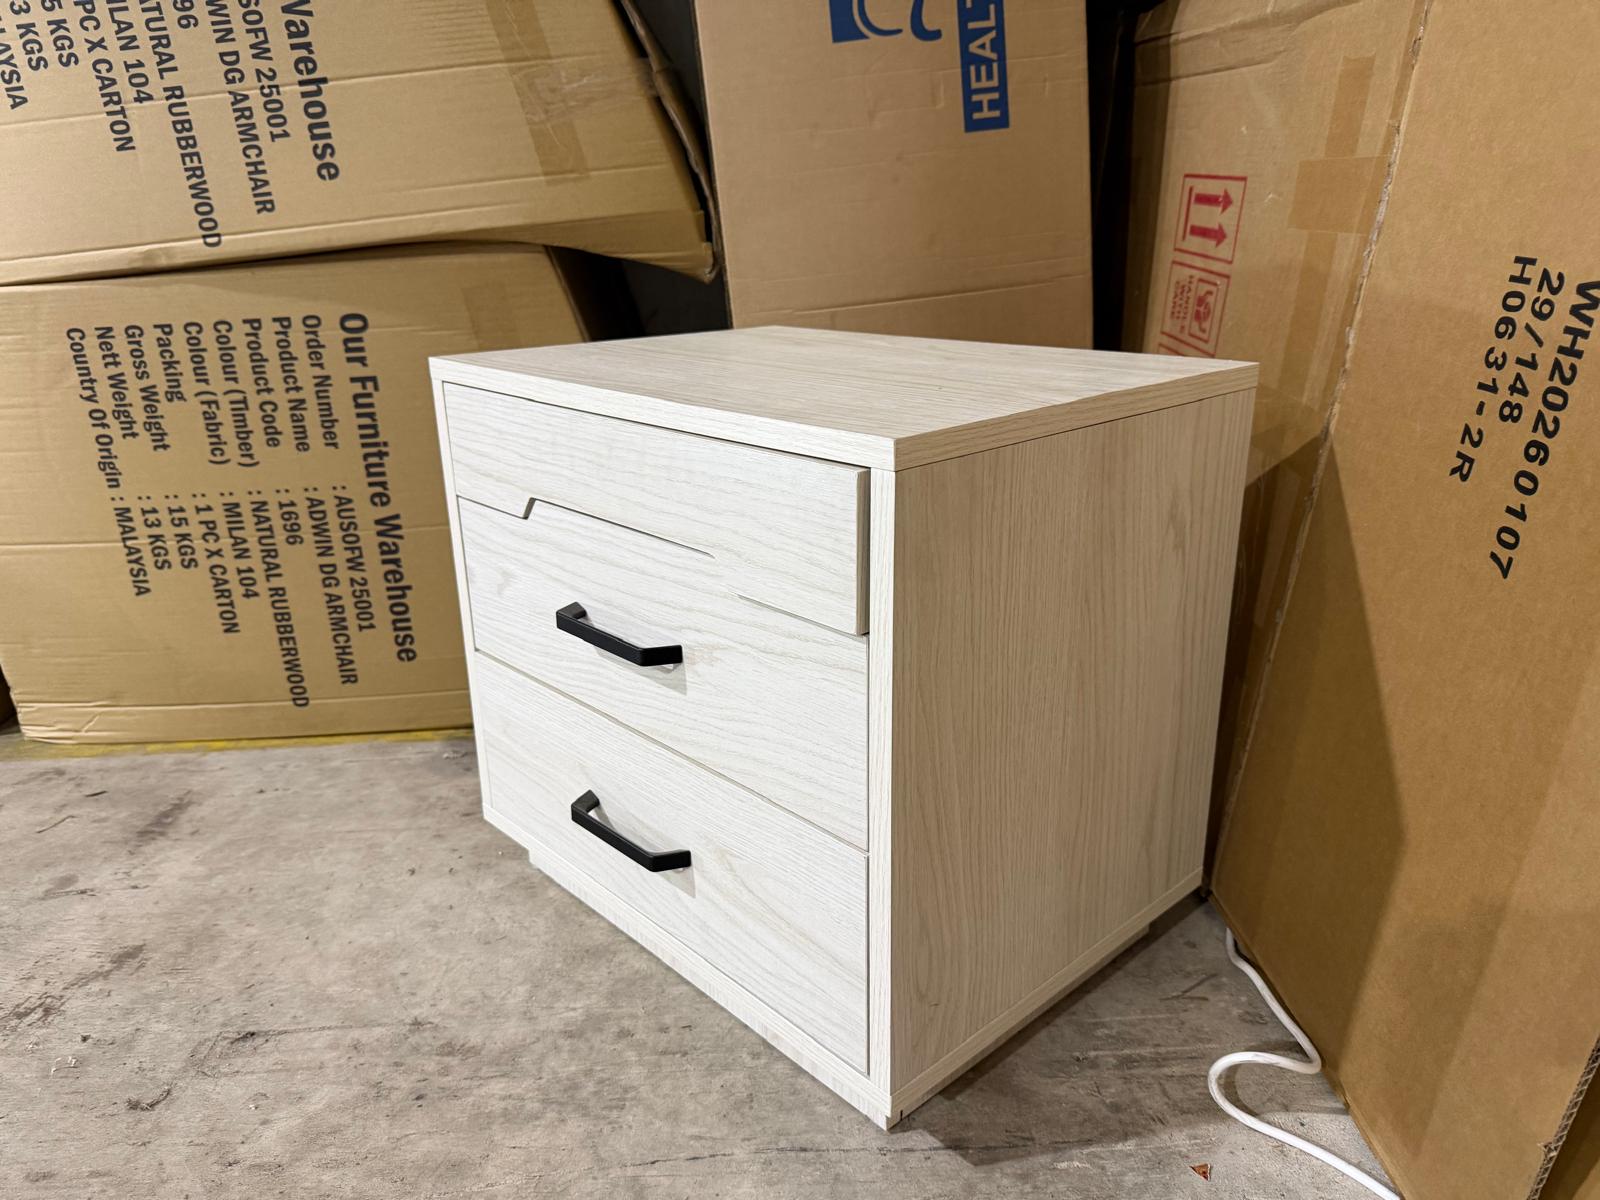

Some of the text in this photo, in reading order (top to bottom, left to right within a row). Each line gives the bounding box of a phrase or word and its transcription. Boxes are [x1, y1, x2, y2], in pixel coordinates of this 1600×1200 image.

[9, 0, 49, 71] 3 KGS
[46, 18, 79, 68] KGS
[218, 50, 245, 85] DG
[73, 0, 136, 152] PC X CARTON
[123, 59, 155, 104] 104
[254, 67, 295, 143] 25001
[162, 85, 222, 248] RUBBERWOOD
[226, 88, 275, 214] ARMCHAIR
[94, 326, 122, 369] Nett
[124, 325, 150, 380] Gross
[153, 323, 187, 403] Packing
[183, 321, 210, 386] Colour
[213, 320, 239, 384] Colour
[242, 318, 275, 396] Product
[271, 316, 303, 394] Product
[302, 315, 326, 370] Order
[107, 372, 139, 440] Weight
[139, 384, 171, 451] Weight
[194, 390, 231, 465] (Fabric)
[222, 389, 260, 467] (Timber)
[258, 400, 283, 448] Code
[287, 398, 310, 452] Name
[312, 375, 339, 449] Number
[66, 328, 99, 404] Country
[95, 434, 122, 489] Origin
[113, 507, 152, 596] MALAYSIA
[339, 313, 417, 662] Our Furniture Warehouse
[140, 507, 162, 529] 13
[167, 506, 189, 528] 15
[194, 504, 214, 515] 1
[198, 520, 220, 543] PC
[222, 502, 252, 560] MILAN
[250, 500, 283, 583] NATURAL
[278, 500, 304, 546] 1696
[305, 497, 335, 557] ADWIN
[333, 495, 366, 572] AUSOFW
[147, 534, 172, 570] KGS
[173, 533, 199, 569] KGS
[204, 548, 224, 560] X
[236, 566, 260, 599] 104
[318, 563, 340, 588] DG
[209, 564, 241, 634] CARTON
[349, 577, 376, 632] 25001
[267, 587, 310, 707] RUBBERWOOD
[324, 592, 358, 685] ARMCHAIR
